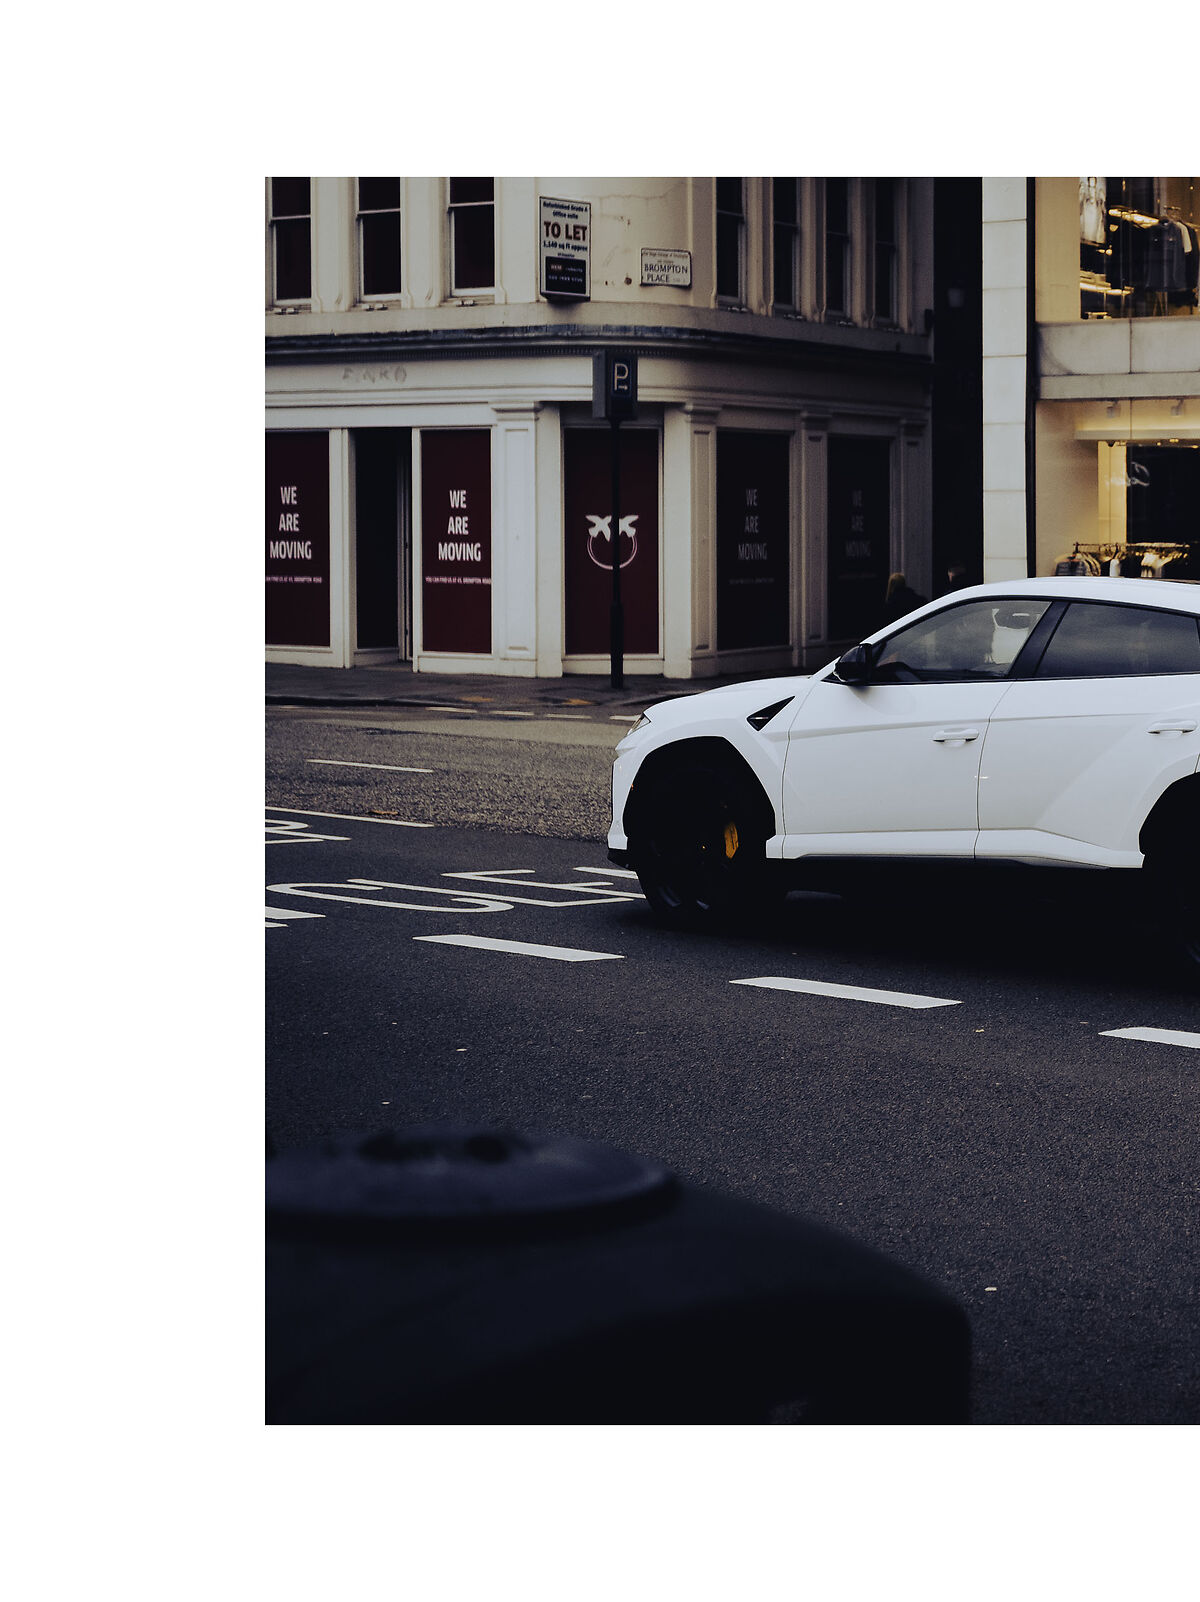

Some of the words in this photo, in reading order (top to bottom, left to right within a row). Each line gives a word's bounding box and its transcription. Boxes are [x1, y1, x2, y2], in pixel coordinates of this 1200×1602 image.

[544, 221, 561, 238] TO
[565, 224, 587, 241] LET
[644, 263, 688, 274] BROMPTON
[647, 274, 670, 282] PLACE
[280, 486, 297, 505] WE
[449, 490, 467, 509] WE
[746, 489, 758, 506] WE
[278, 513, 300, 532] ARE
[448, 516, 469, 535] ARE
[745, 516, 759, 533] ARE
[270, 541, 312, 560] MOVING
[438, 542, 482, 561] MOVING
[738, 543, 768, 560] MOVING
